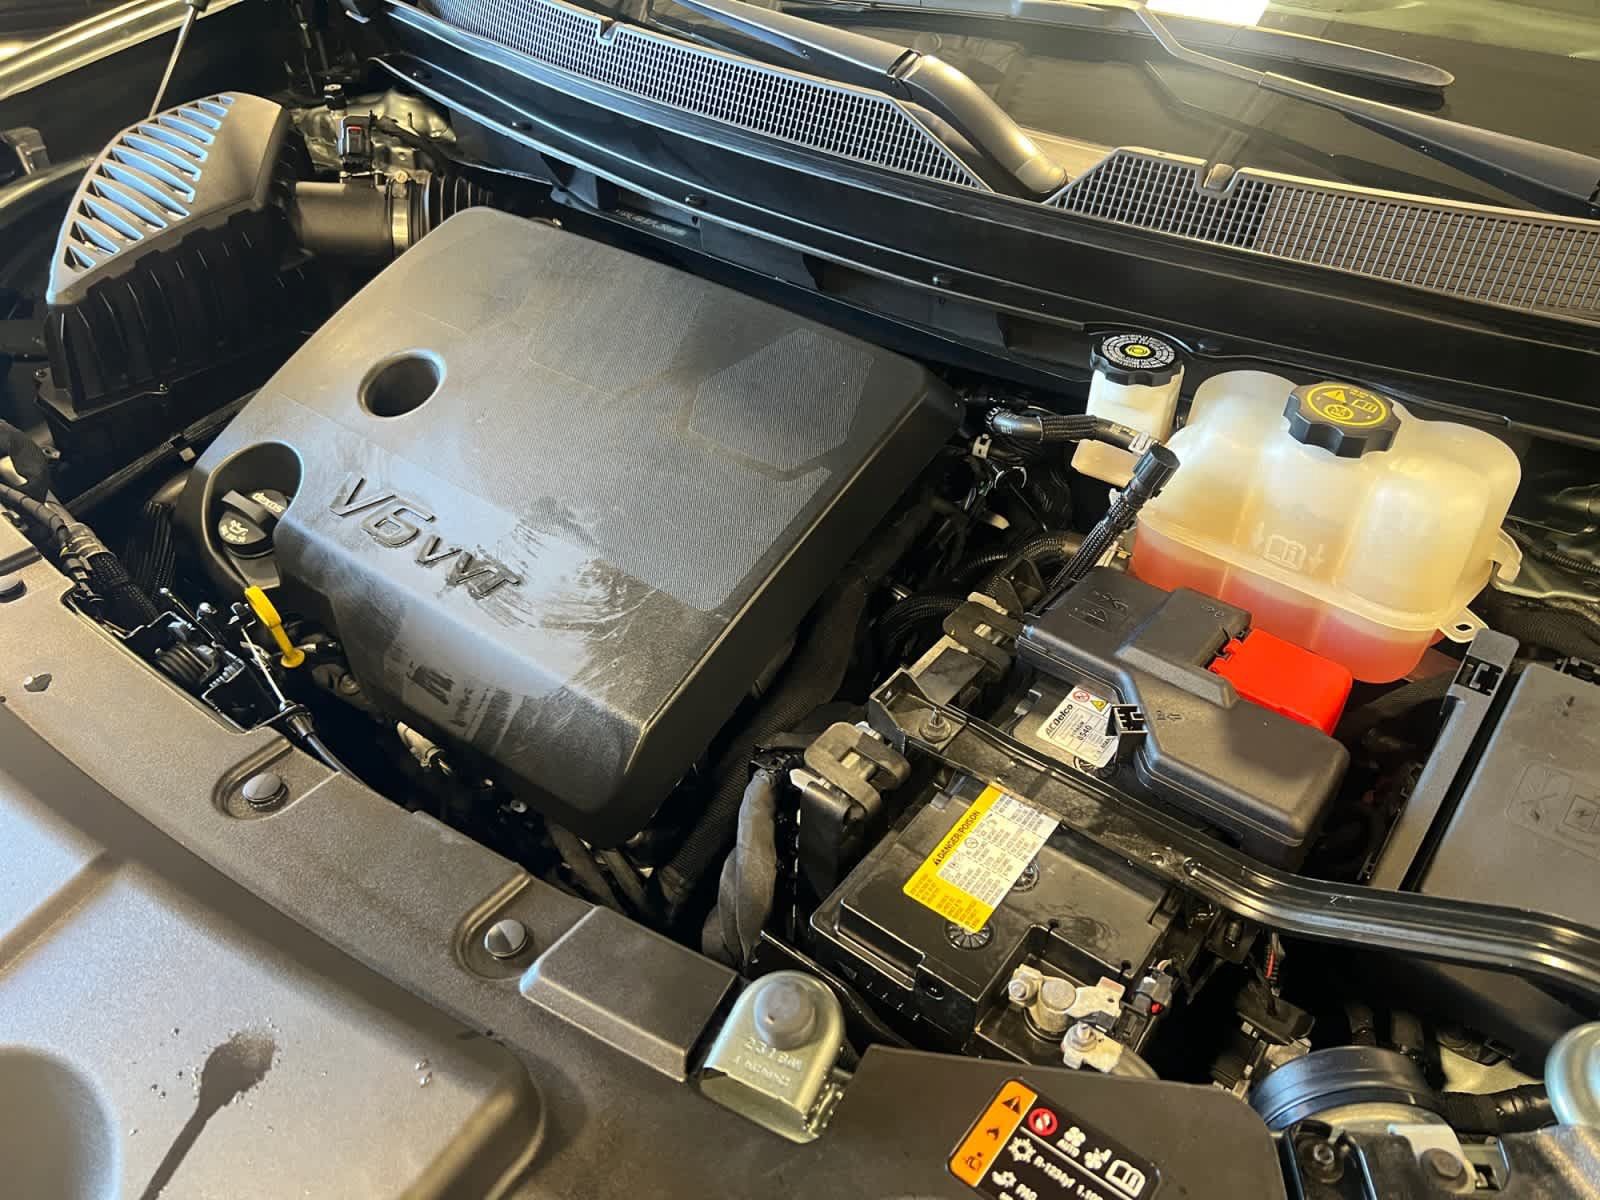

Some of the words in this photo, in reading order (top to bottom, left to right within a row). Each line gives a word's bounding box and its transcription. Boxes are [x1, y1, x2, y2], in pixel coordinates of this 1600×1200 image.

[252, 492, 286, 513] dexos
[328, 473, 435, 548] V6
[1044, 703, 1074, 738] ACDelco
